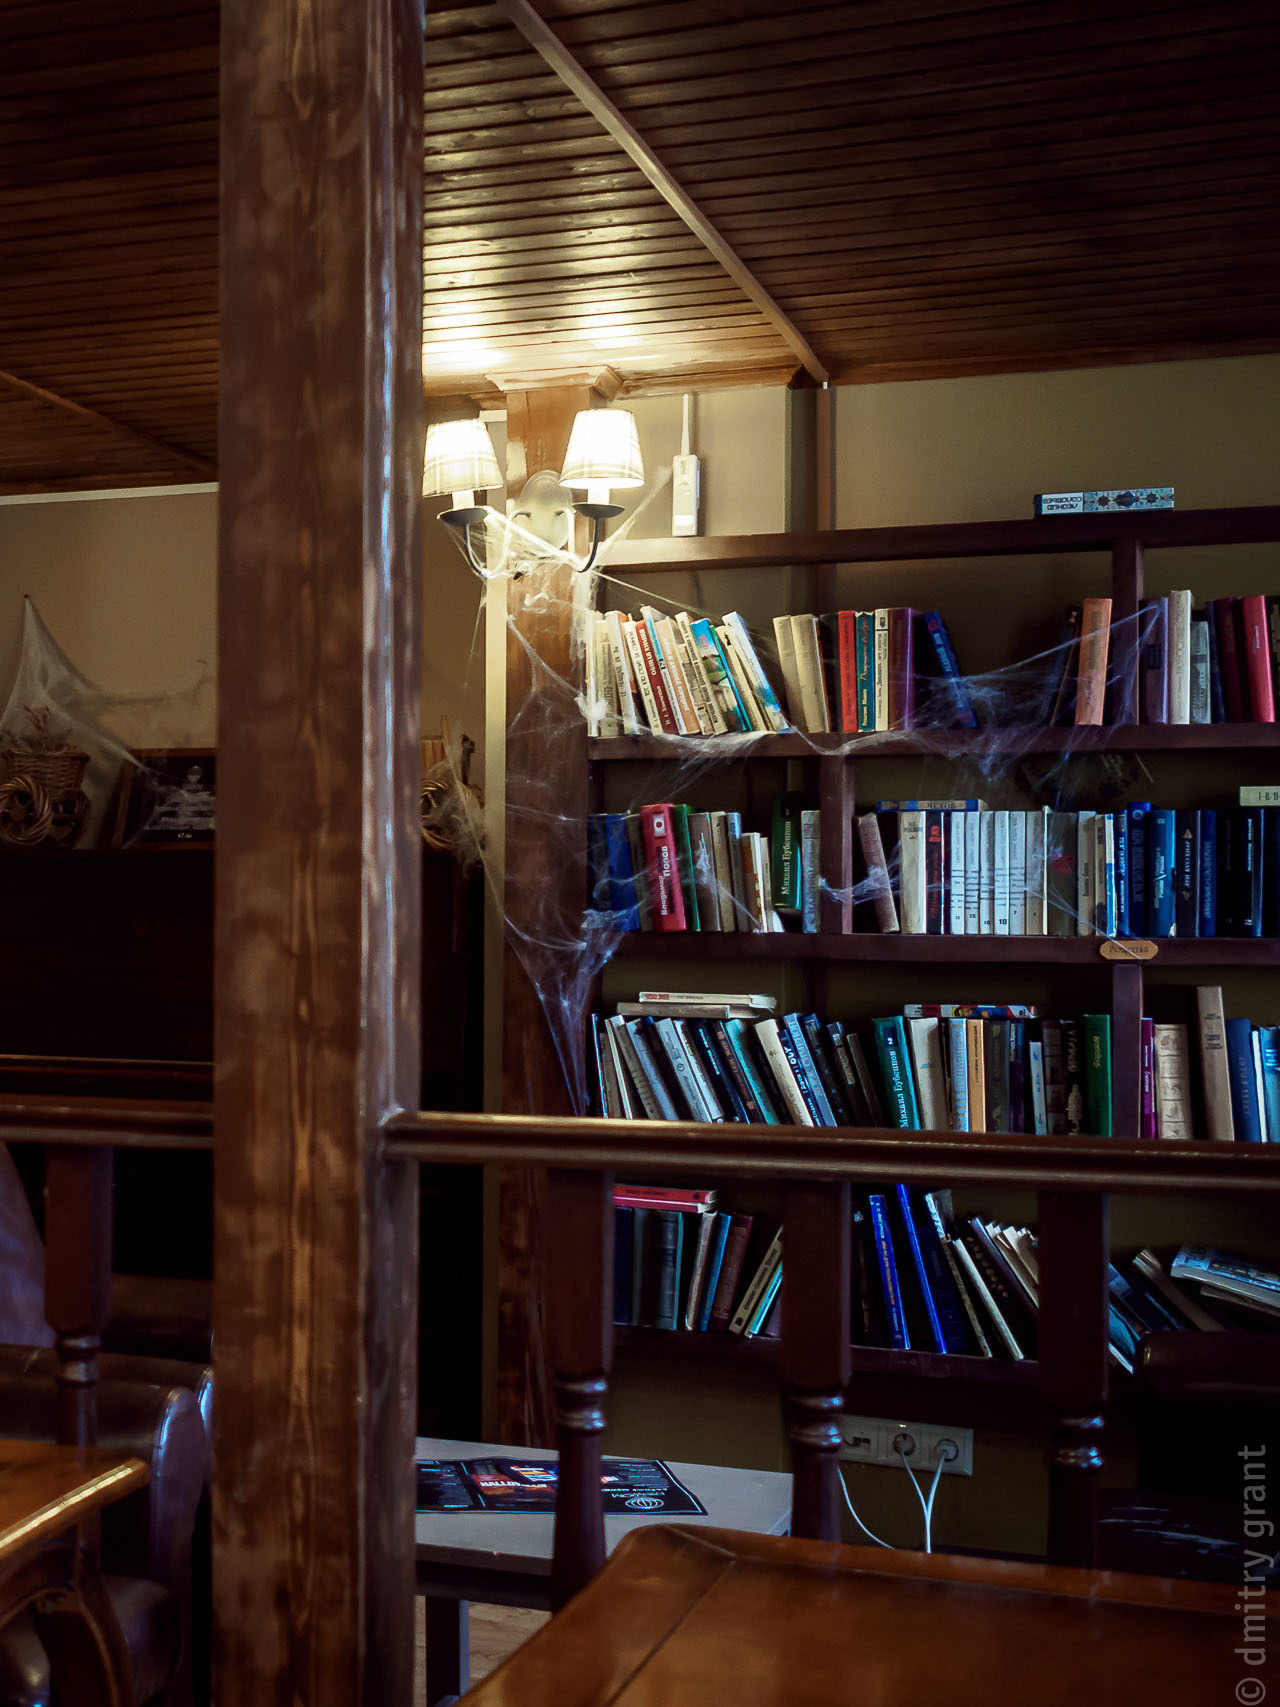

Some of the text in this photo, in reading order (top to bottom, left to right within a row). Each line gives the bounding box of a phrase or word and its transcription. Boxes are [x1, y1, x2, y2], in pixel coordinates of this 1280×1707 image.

[661, 845, 671, 877] Попов
[781, 862, 791, 895] Михаил
[658, 875, 668, 916] Владимир
[889, 1050, 909, 1127] Михаил Бубеннов
